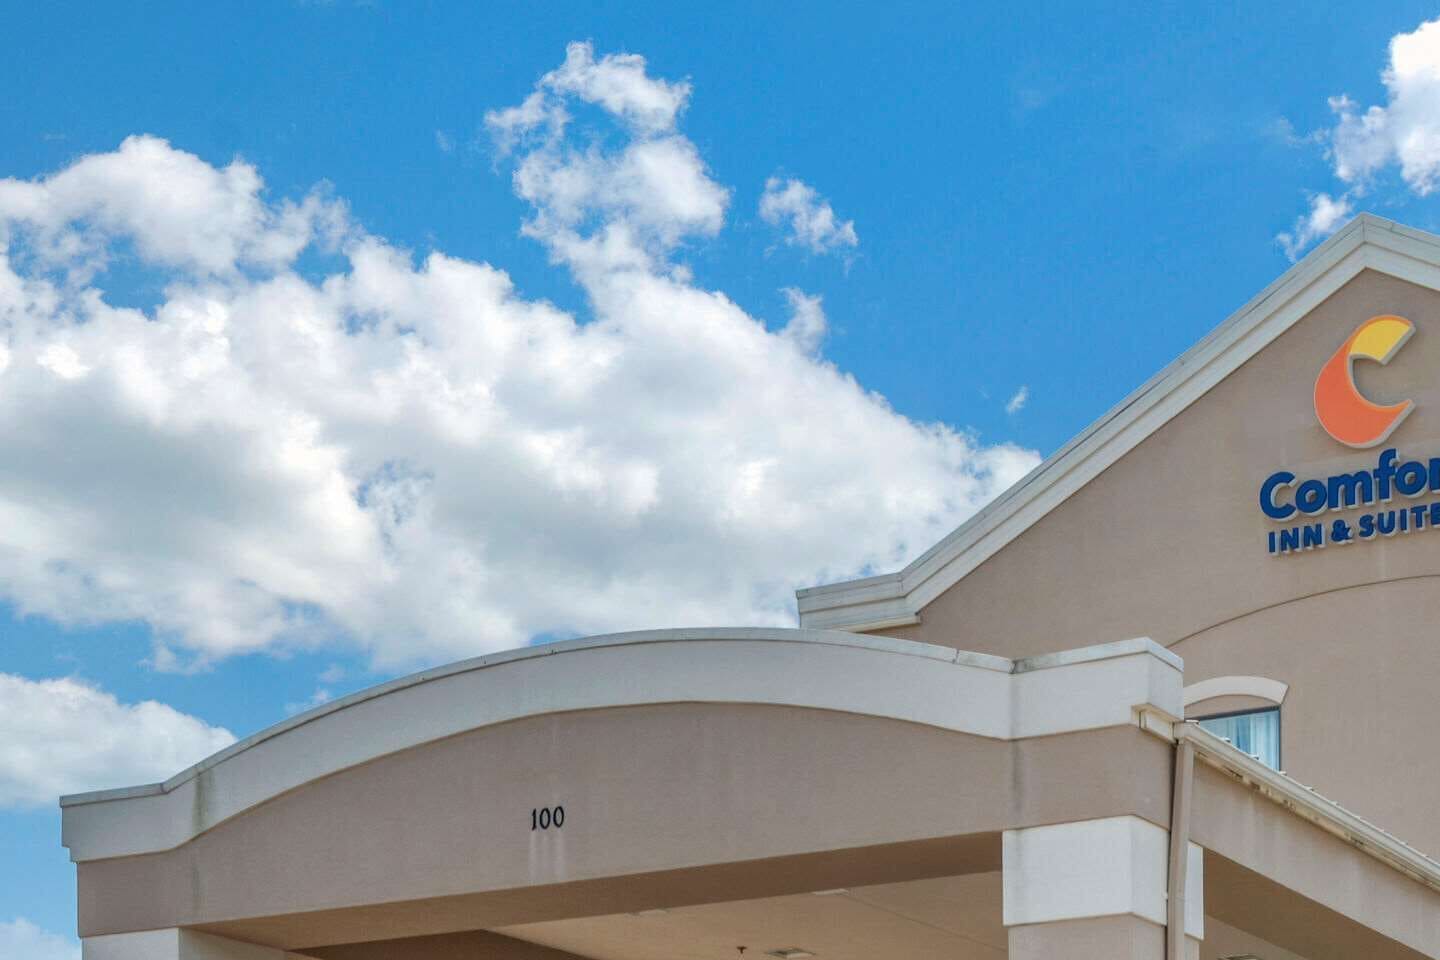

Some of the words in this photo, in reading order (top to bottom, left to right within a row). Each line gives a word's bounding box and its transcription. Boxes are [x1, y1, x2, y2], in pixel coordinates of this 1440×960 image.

[1268, 523, 1326, 556] INN
[1330, 519, 1354, 545] &
[531, 805, 565, 831] 100
